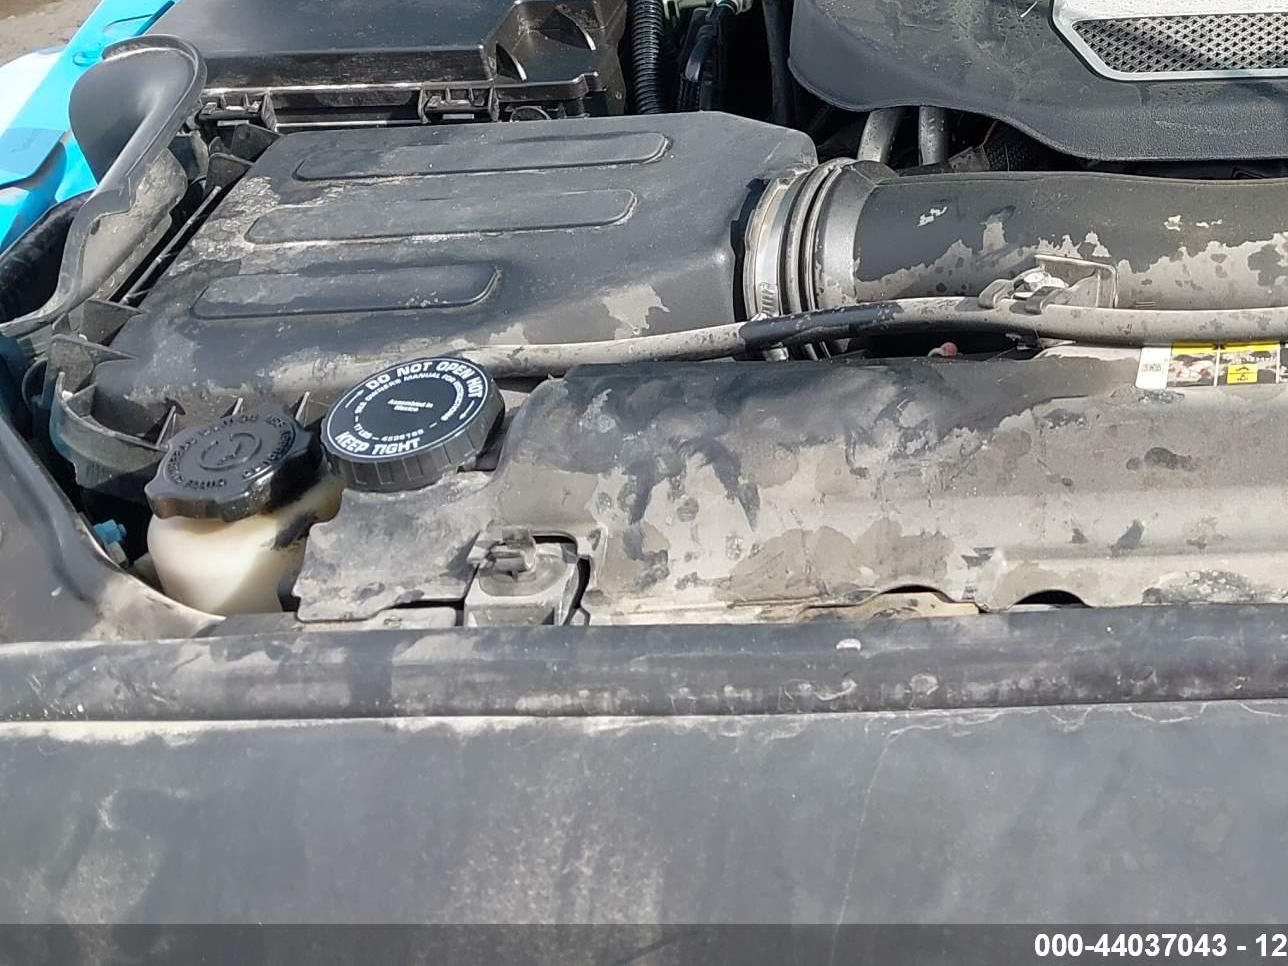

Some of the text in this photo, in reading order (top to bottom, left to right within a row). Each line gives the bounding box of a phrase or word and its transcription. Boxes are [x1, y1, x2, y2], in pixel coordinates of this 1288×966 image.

[364, 378, 402, 401] OWNERS
[403, 372, 440, 382] MANUAL
[365, 361, 483, 398] DO NOT OPEN HOT
[334, 431, 421, 455] KEEP TIGHT
